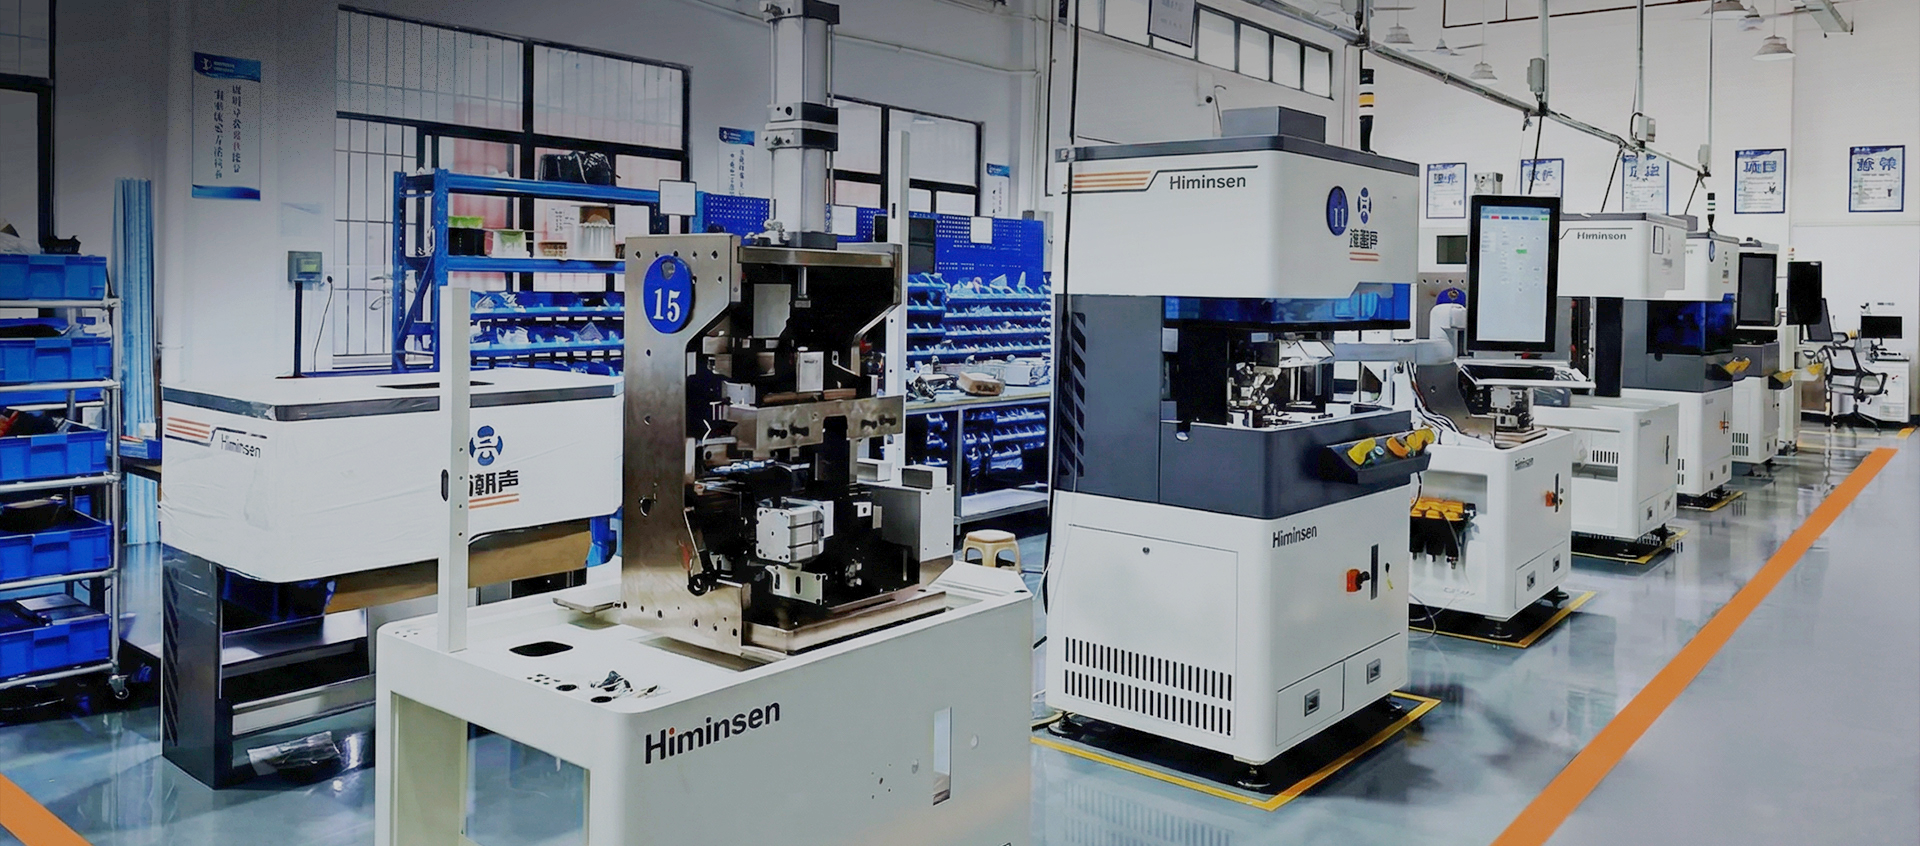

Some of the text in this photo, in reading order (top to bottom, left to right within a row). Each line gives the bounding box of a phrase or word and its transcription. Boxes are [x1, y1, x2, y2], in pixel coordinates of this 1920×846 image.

[1169, 175, 1246, 190] Himinsen
[1333, 207, 1346, 228] 11
[653, 287, 681, 323] 15
[1272, 525, 1317, 549] Himinsen
[645, 702, 780, 764] Himinsen
